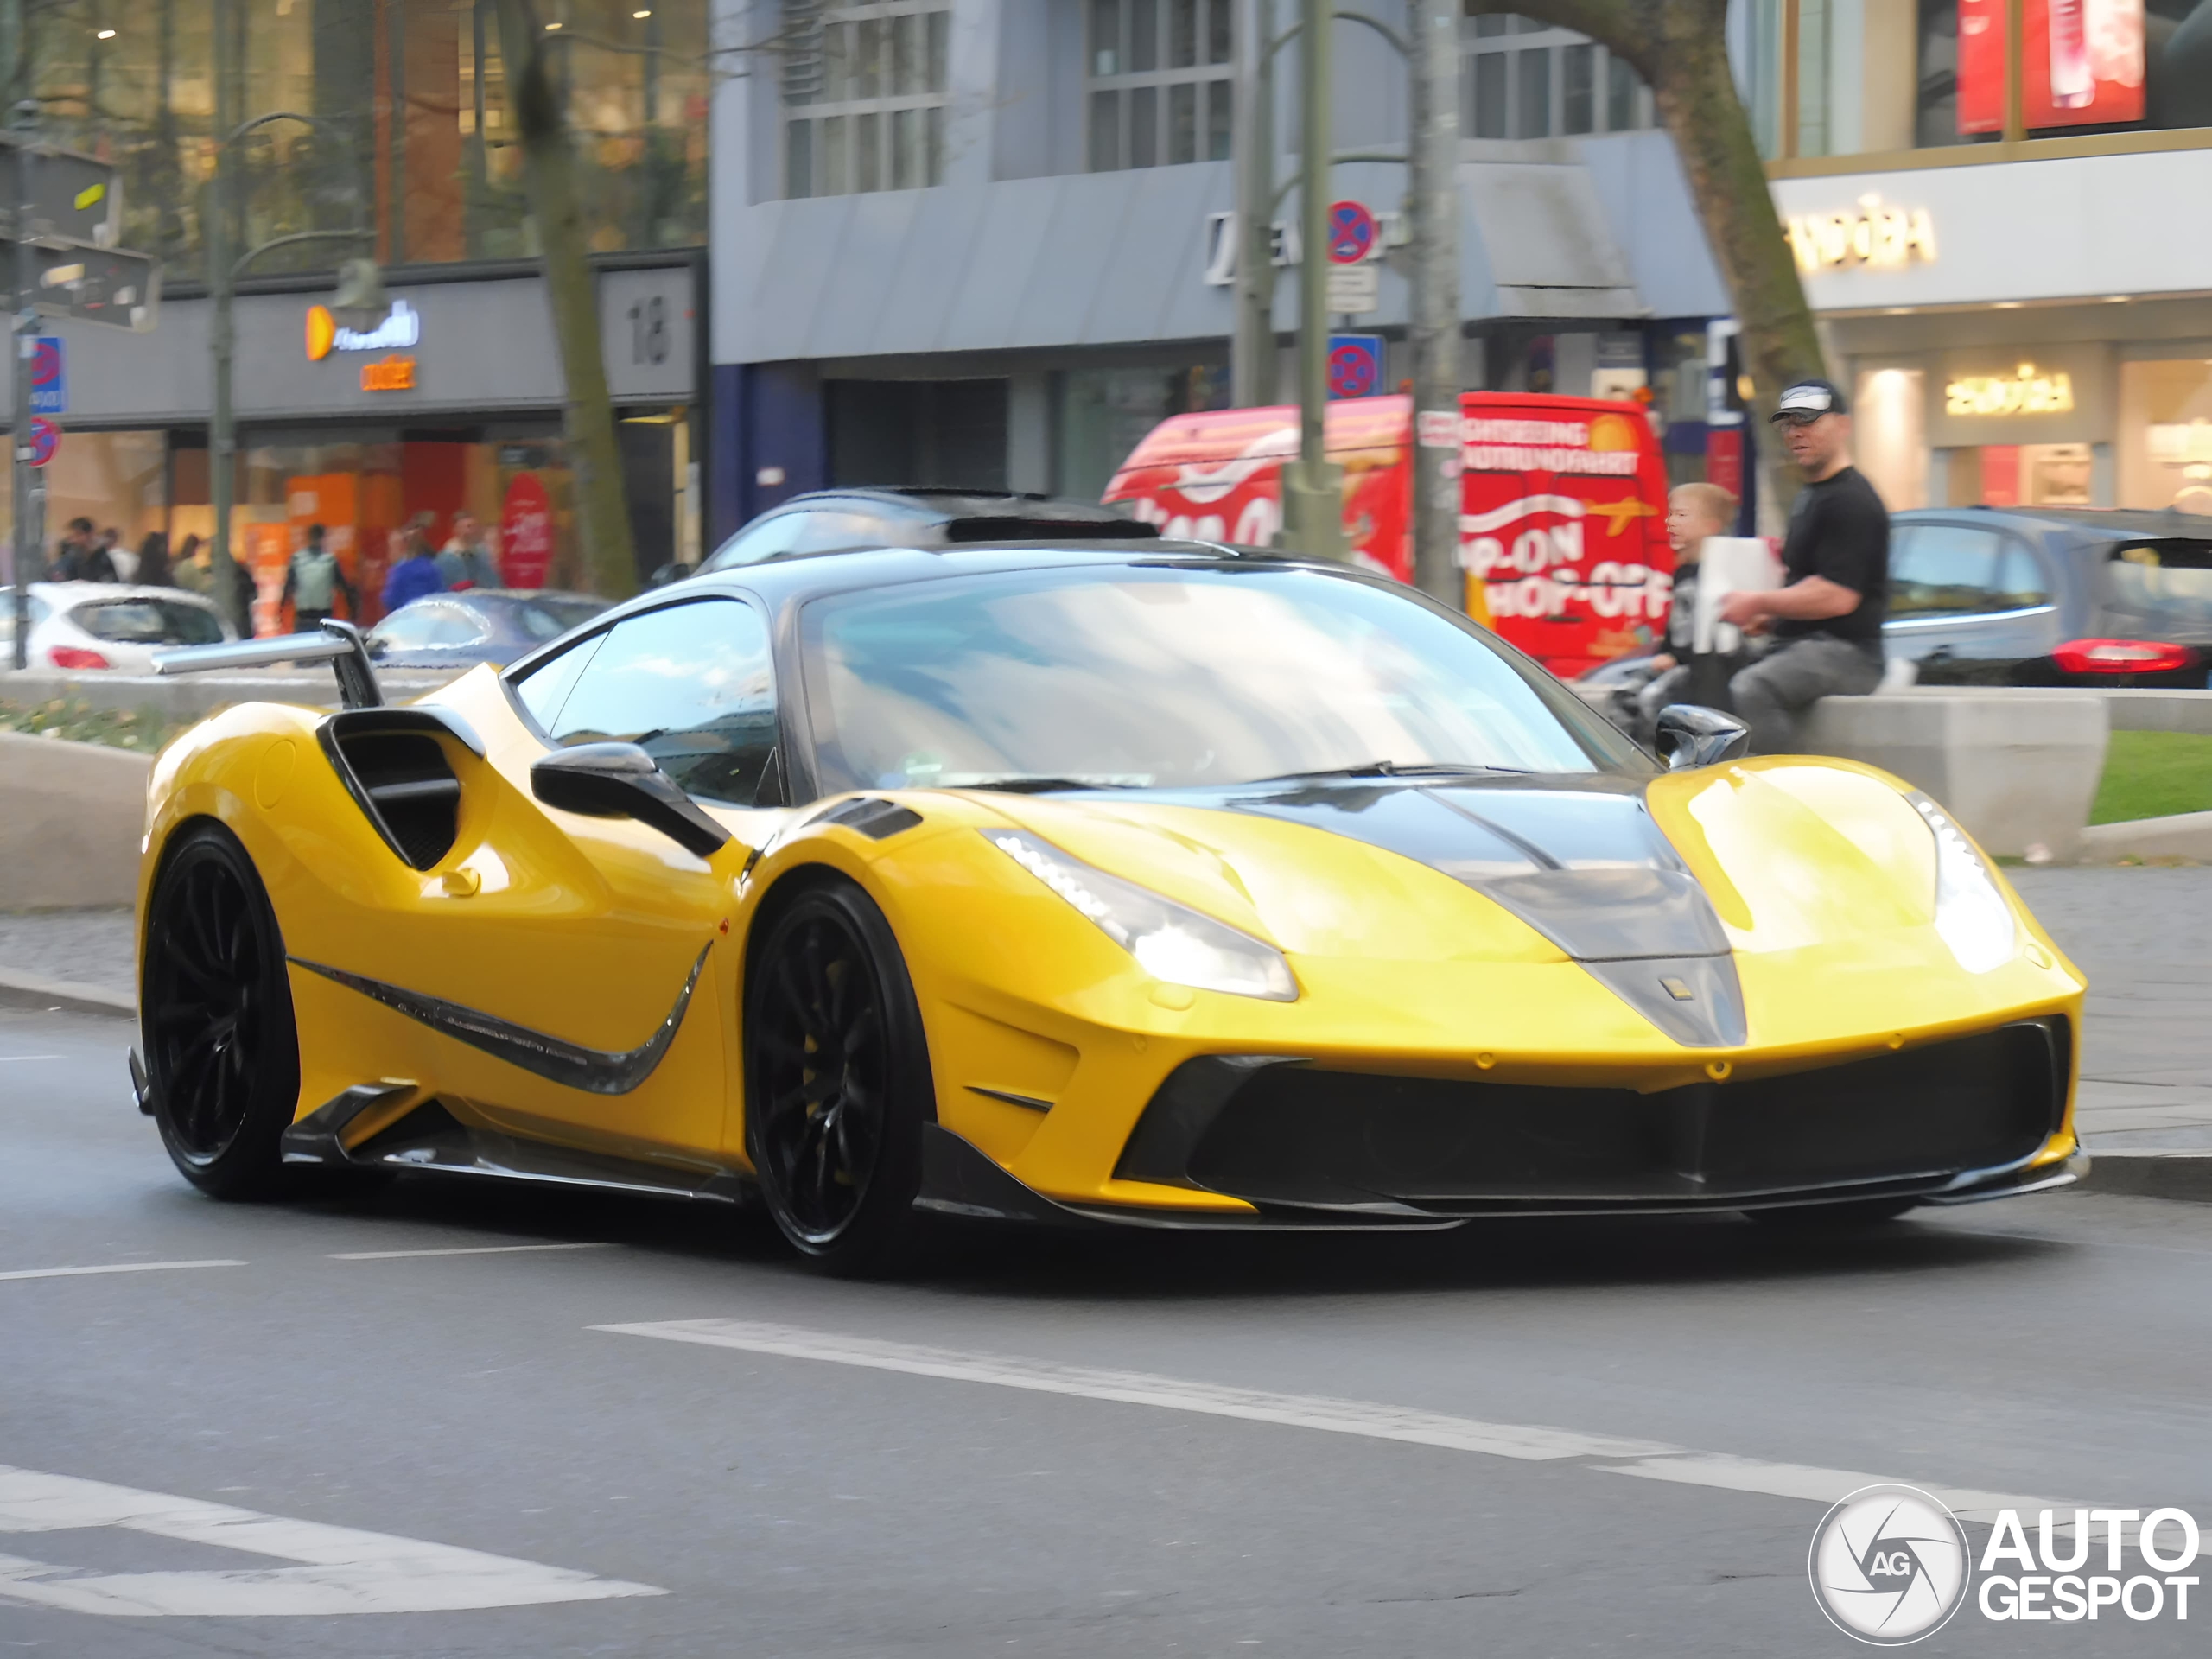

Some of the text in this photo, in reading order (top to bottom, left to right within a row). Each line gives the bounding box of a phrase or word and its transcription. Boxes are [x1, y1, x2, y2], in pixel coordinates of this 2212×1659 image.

[1783, 194, 1936, 270] NDORA
[627, 296, 672, 365] 18
[1460, 521, 1584, 577] P-ON
[1484, 562, 1674, 618] HOP-OFF
